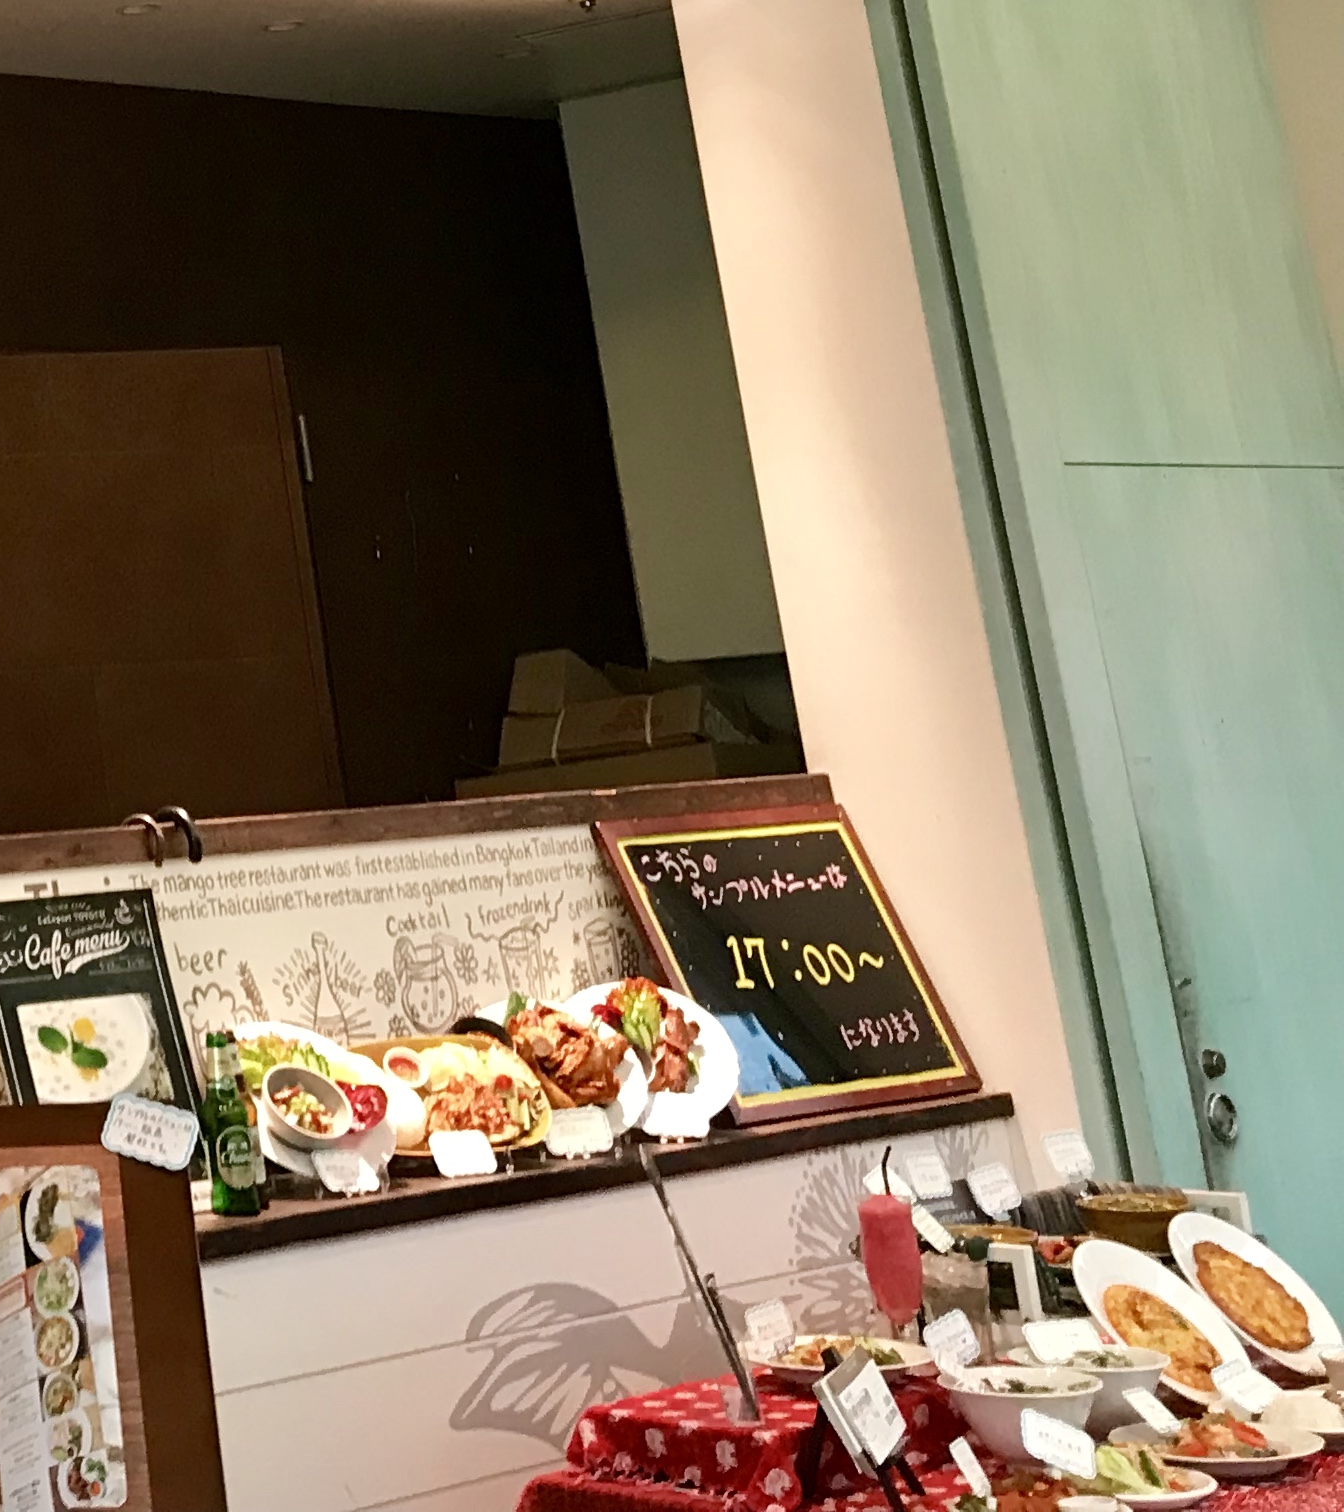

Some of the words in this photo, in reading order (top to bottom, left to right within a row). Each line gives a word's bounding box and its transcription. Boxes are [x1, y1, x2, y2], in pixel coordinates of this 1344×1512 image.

[164, 873, 215, 898] mango
[216, 868, 247, 890] tree
[249, 861, 321, 887] restaurant
[323, 859, 352, 878] was
[640, 848, 719, 884] こちらの
[691, 863, 849, 911] サンプルメニューは
[385, 902, 451, 937] Cocktail
[24, 929, 74, 980] Cafe
[74, 928, 122, 954] menu
[172, 941, 229, 976] beer
[840, 1008, 922, 1052] になります
